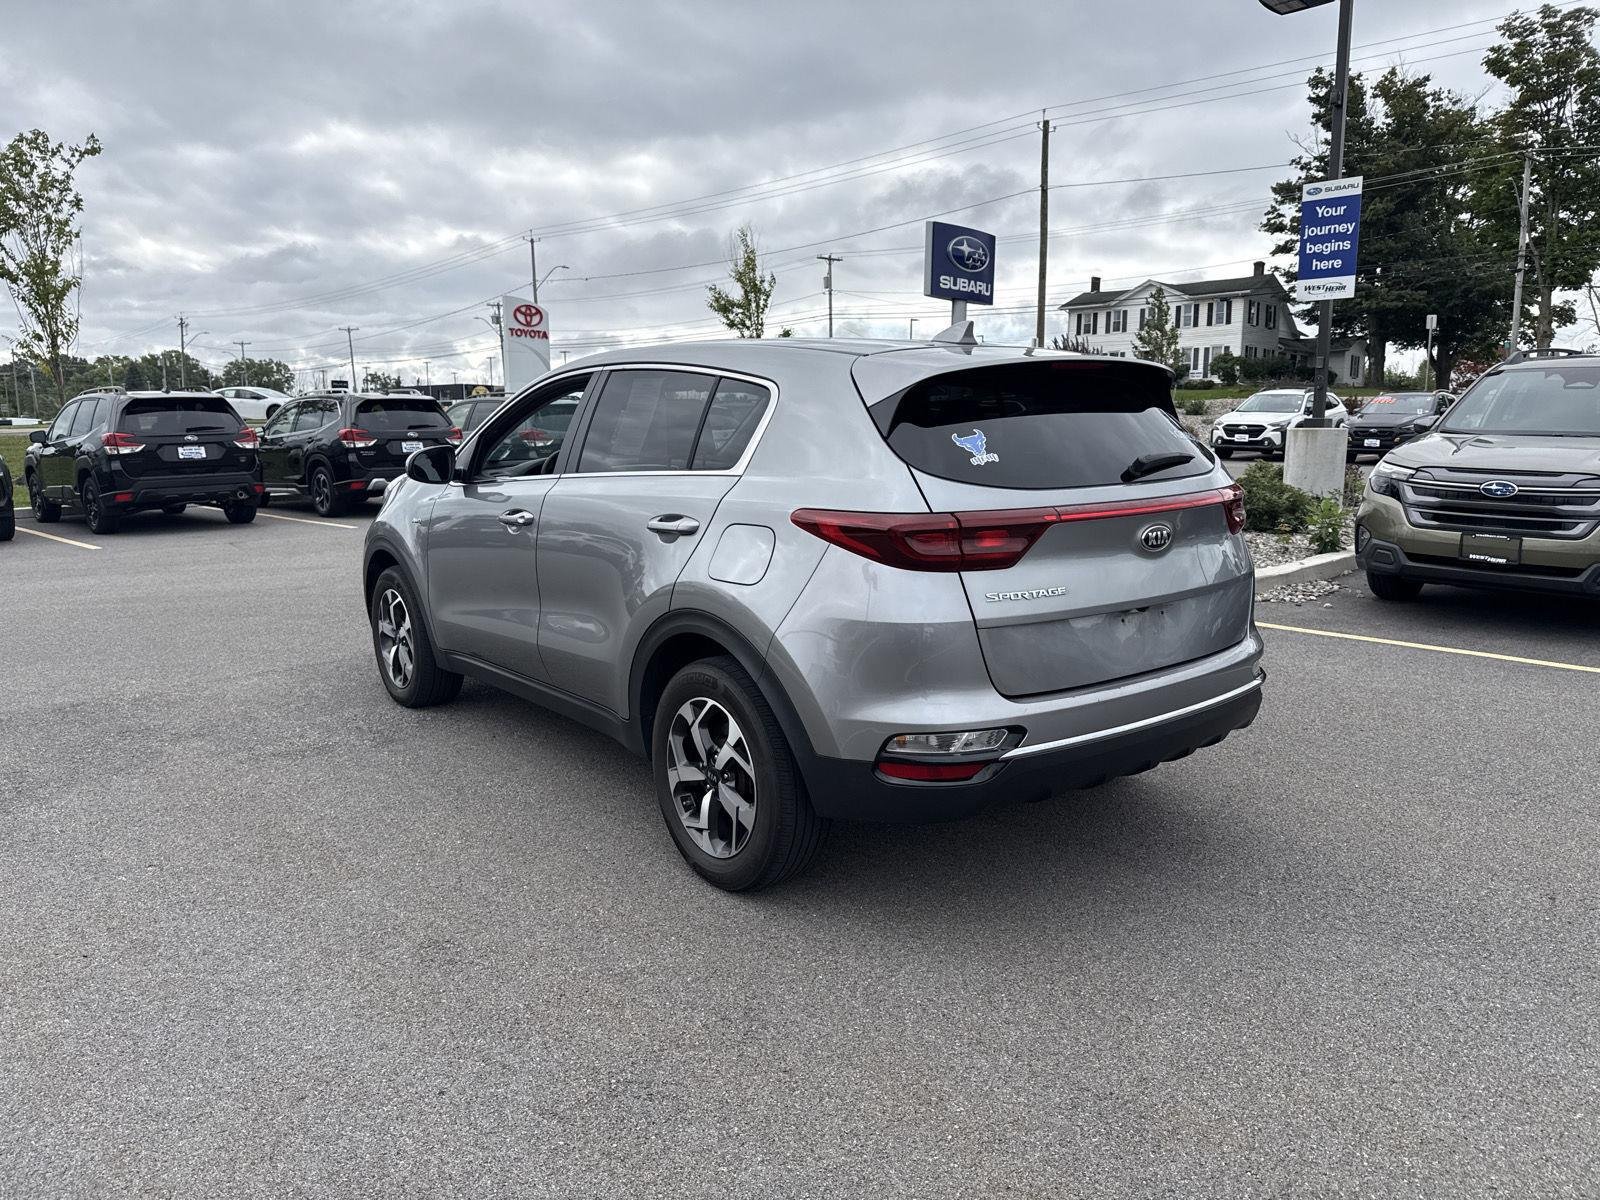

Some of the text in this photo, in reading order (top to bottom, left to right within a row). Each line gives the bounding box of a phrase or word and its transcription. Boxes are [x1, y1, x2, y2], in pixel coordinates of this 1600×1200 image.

[1324, 183, 1360, 193] SUBARU
[1315, 205, 1347, 218] Your
[1303, 222, 1356, 240] journey
[1306, 239, 1351, 255] begins
[1312, 259, 1342, 271] here
[940, 275, 991, 296] SUBARU
[508, 327, 549, 340] TOYOTA
[1148, 530, 1169, 546] KIA
[984, 586, 1067, 602] SPORTAGE
